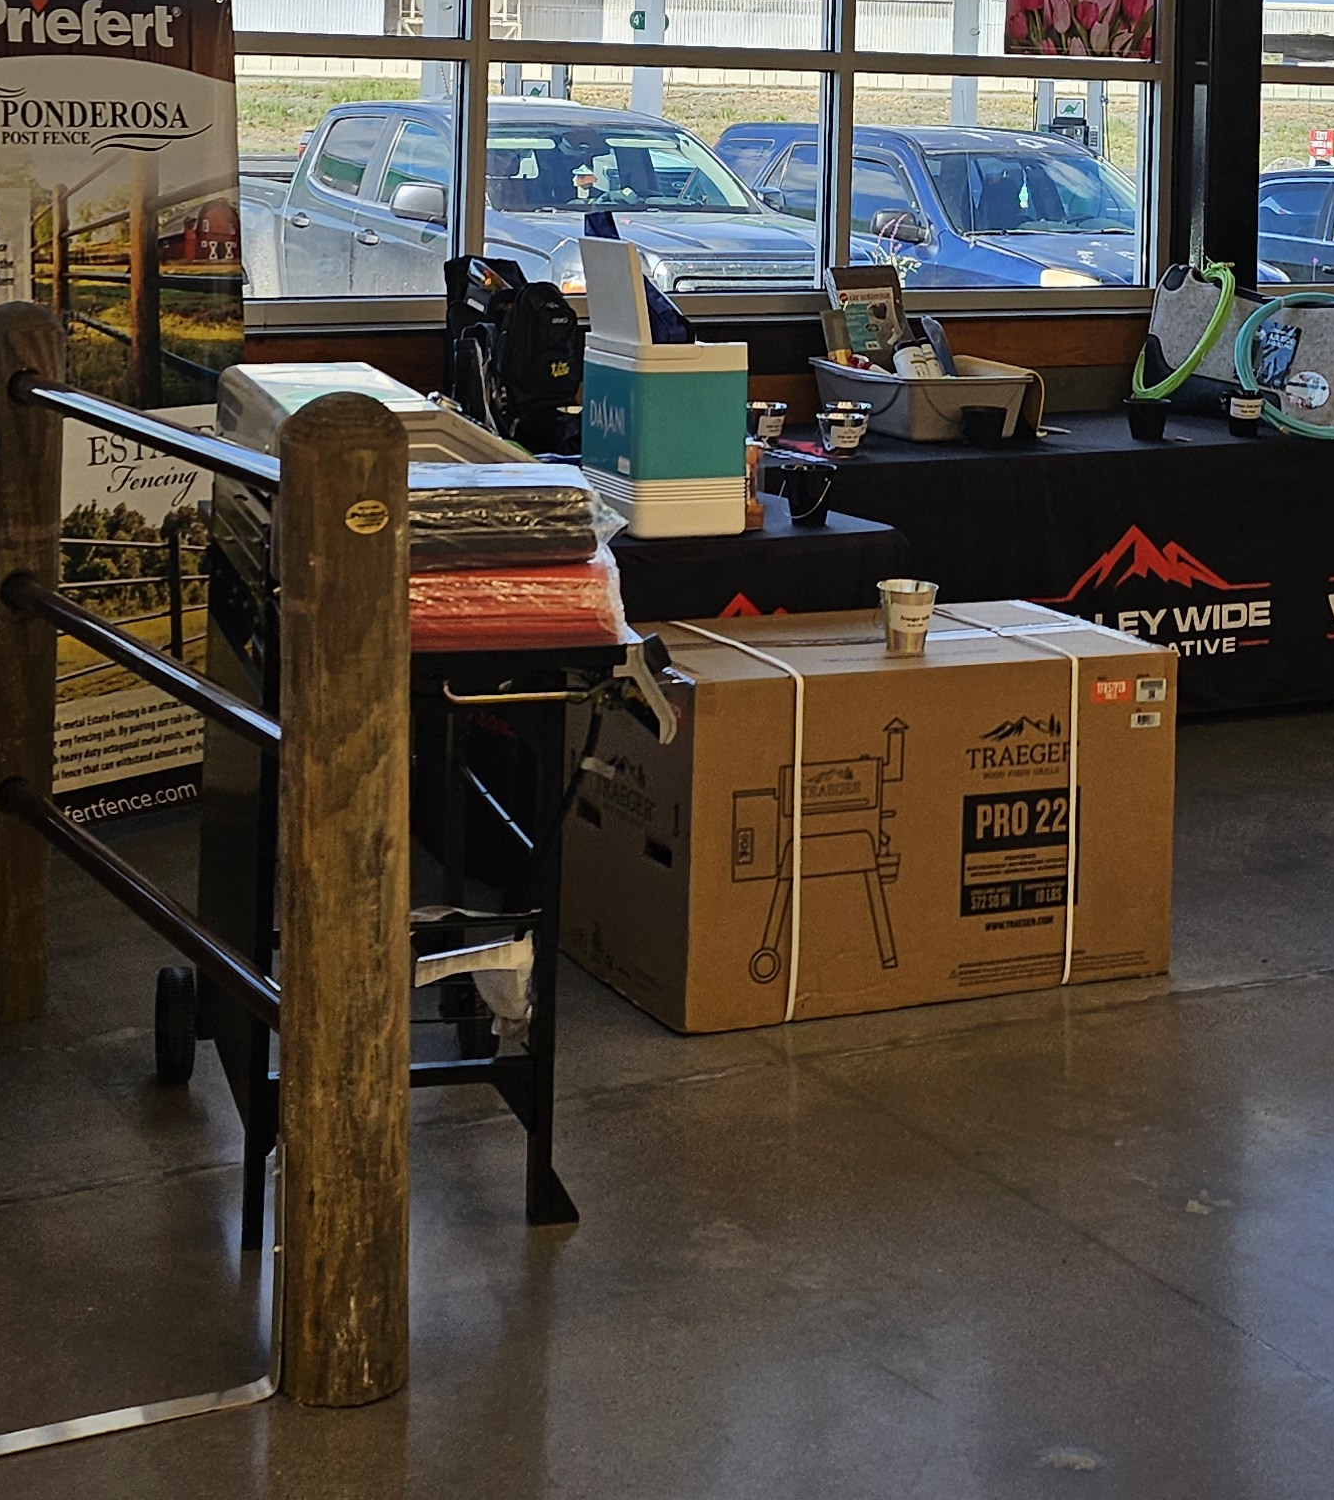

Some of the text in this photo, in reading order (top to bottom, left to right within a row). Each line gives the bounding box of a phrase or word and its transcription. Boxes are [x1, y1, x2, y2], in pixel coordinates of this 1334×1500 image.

[0, 100, 189, 129] PONDEROSA
[2, 131, 40, 145] POST
[42, 131, 91, 145] FENCE
[589, 395, 625, 437] DASANI
[107, 465, 198, 507] Fencing
[1173, 600, 1271, 632] WIDE
[1168, 637, 1237, 658] ATIVE
[63, 783, 197, 823] fertfence.com
[976, 797, 1068, 839] PRO 22
